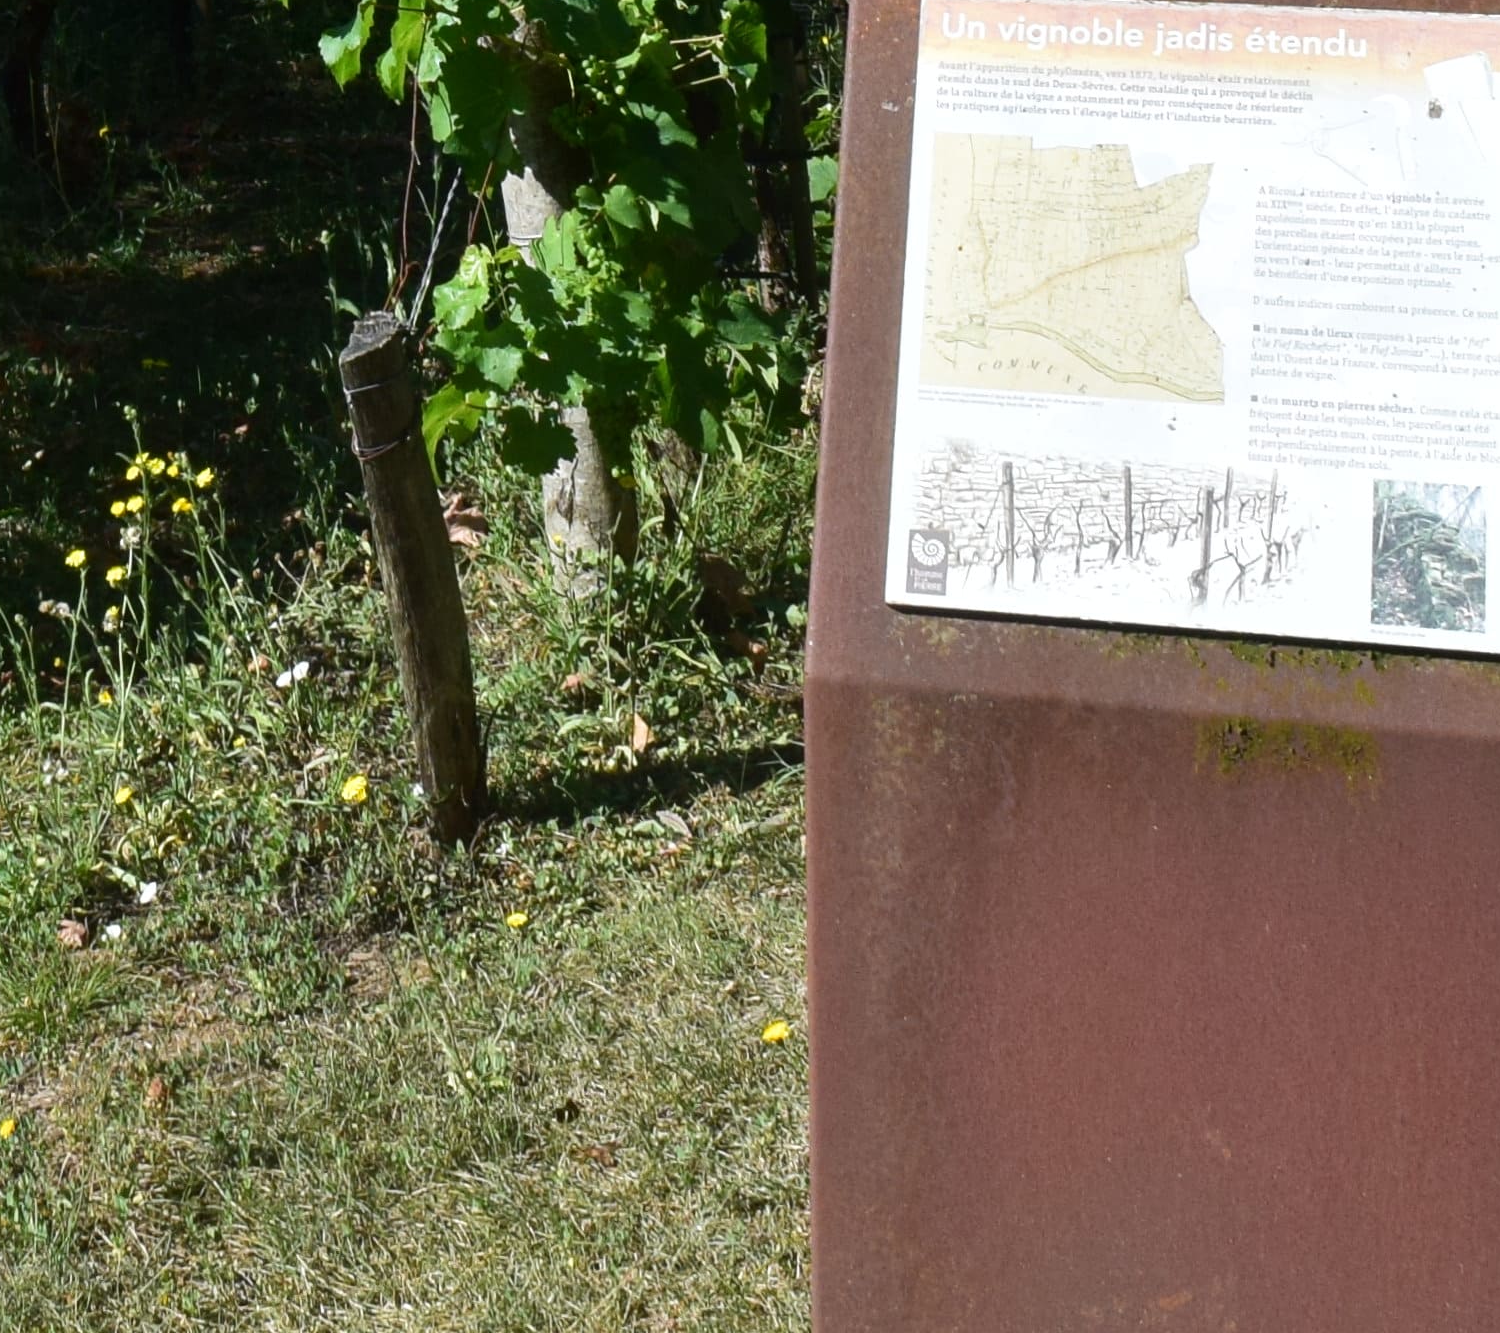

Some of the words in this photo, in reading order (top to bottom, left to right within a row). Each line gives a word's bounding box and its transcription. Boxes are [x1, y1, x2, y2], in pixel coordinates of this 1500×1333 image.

[941, 12, 986, 41] Un
[998, 16, 1144, 51] vignoble
[1152, 22, 1233, 55] jadis
[1244, 28, 1368, 58] étendu
[938, 59, 968, 70] Avant
[968, 61, 1029, 75] l'apparition
[1031, 64, 1044, 74] du
[1170, 71, 1215, 85] vignoble
[1243, 75, 1310, 87] relativement
[937, 72, 972, 84] étendu
[974, 74, 999, 85] dans
[1012, 76, 1031, 87] sud
[1032, 77, 1050, 88] des
[1052, 78, 1117, 91] Deux-Sèvres.
[1119, 81, 1146, 93] Cette
[1148, 82, 1189, 95] maladie
[1191, 84, 1208, 98] qui
[1219, 86, 1267, 101] provoqué
[1281, 89, 1313, 101] déclin
[936, 85, 948, 96] de
[963, 86, 998, 98] culture
[1000, 88, 1012, 99] de
[1026, 89, 1055, 103] vigne
[1065, 91, 1124, 105] notamment
[1142, 98, 1164, 109] pour
[1167, 96, 1232, 112] conséquence
[1235, 100, 1248, 111] de
[1250, 100, 1303, 114] réorienter
[936, 98, 950, 109] les
[952, 99, 999, 114] pratiques
[1049, 107, 1070, 115] vers
[1072, 105, 1118, 120] l'élevage
[1120, 107, 1151, 119] laitier
[1166, 110, 1221, 123] l'industrie
[1299, 187, 1358, 199] l'existence
[1360, 190, 1384, 201] d'un
[1386, 192, 1432, 206] vignoble
[1434, 194, 1450, 205] est
[1452, 195, 1485, 206] avérée
[1306, 201, 1336, 212] siècle.
[1340, 203, 1352, 213] En
[1384, 205, 1430, 219] l'analyse
[1432, 208, 1445, 218] du
[1447, 209, 1490, 221] cadastre
[1255, 212, 1317, 227] napoléonien
[1319, 215, 1355, 227] montre
[1358, 217, 1387, 231] qu'en
[1391, 219, 1413, 230] 1831
[1428, 221, 1464, 235] plupart
[1255, 226, 1272, 236] des
[1274, 227, 1318, 241] parcelles
[1320, 230, 1355, 241] étaient
[1358, 232, 1404, 246] occupées
[1407, 237, 1423, 247] par
[1425, 235, 1441, 246] des
[1255, 240, 1318, 253] L'orientation
[1321, 244, 1364, 258] générale
[1366, 246, 1378, 256] de
[1393, 248, 1422, 261] pente
[1430, 252, 1452, 260] vers
[1254, 256, 1267, 264] ou
[1269, 257, 1289, 265] vers
[1334, 258, 1354, 269] leur
[1357, 259, 1409, 274] permettait
[1413, 263, 1461, 275] d'ailleurs
[1253, 268, 1266, 278] de
[1268, 268, 1317, 281] bénéficier
[1320, 271, 1348, 282] d'une
[1351, 273, 1404, 288] exposition
[1253, 295, 1296, 307] D'autres
[1297, 297, 1333, 309] indices
[1335, 300, 1395, 313] corroborent
[1411, 305, 1458, 320] présence.
[1462, 308, 1474, 319] Ce
[1477, 309, 1498, 320] sont
[1263, 324, 1277, 334] les
[1280, 327, 1309, 336] noms
[1311, 327, 1324, 337] de
[1327, 328, 1353, 339] lieux
[1356, 329, 1405, 344] composés
[1416, 333, 1444, 347] partir
[1447, 335, 1460, 346] de
[1250, 351, 1274, 362] dans
[1277, 353, 1312, 364] l'Ouest
[1315, 355, 1328, 365] de
[1342, 357, 1378, 369] France,
[1381, 359, 1439, 374] correspond
[1450, 366, 1469, 374] une
[1451, 350, 1482, 361] terme
[1250, 365, 1288, 379] plantée
[1290, 368, 1302, 378] de
[1305, 369, 1336, 382] vigne.
[1261, 394, 1278, 405] des
[1281, 396, 1318, 408] murets
[1321, 401, 1334, 409] en
[1337, 399, 1375, 414] pierres
[1378, 402, 1416, 415] sèches.
[1419, 405, 1457, 417] Comme
[1459, 408, 1480, 419] cela
[1249, 408, 1292, 422] fréquent
[1295, 411, 1318, 422] dans
[1321, 413, 1335, 423] les
[1337, 414, 1389, 429] vignobles,
[1392, 418, 1405, 428] les
[1408, 419, 1452, 433] parcelles
[1454, 422, 1471, 432] ont
[1473, 423, 1489, 433] été
[1294, 425, 1306, 435] de
[1308, 426, 1337, 439] petits
[1342, 430, 1368, 440] murs,
[1371, 430, 1423, 443] construits
[1260, 437, 1366, 456] perpendiculairement
[1390, 446, 1421, 460] pente,
[1433, 449, 1462, 460] l'aide
[1465, 451, 1477, 461] de
[1275, 453, 1288, 463] de
[1289, 454, 1346, 469] l'épierrage
[1348, 458, 1365, 468] des
